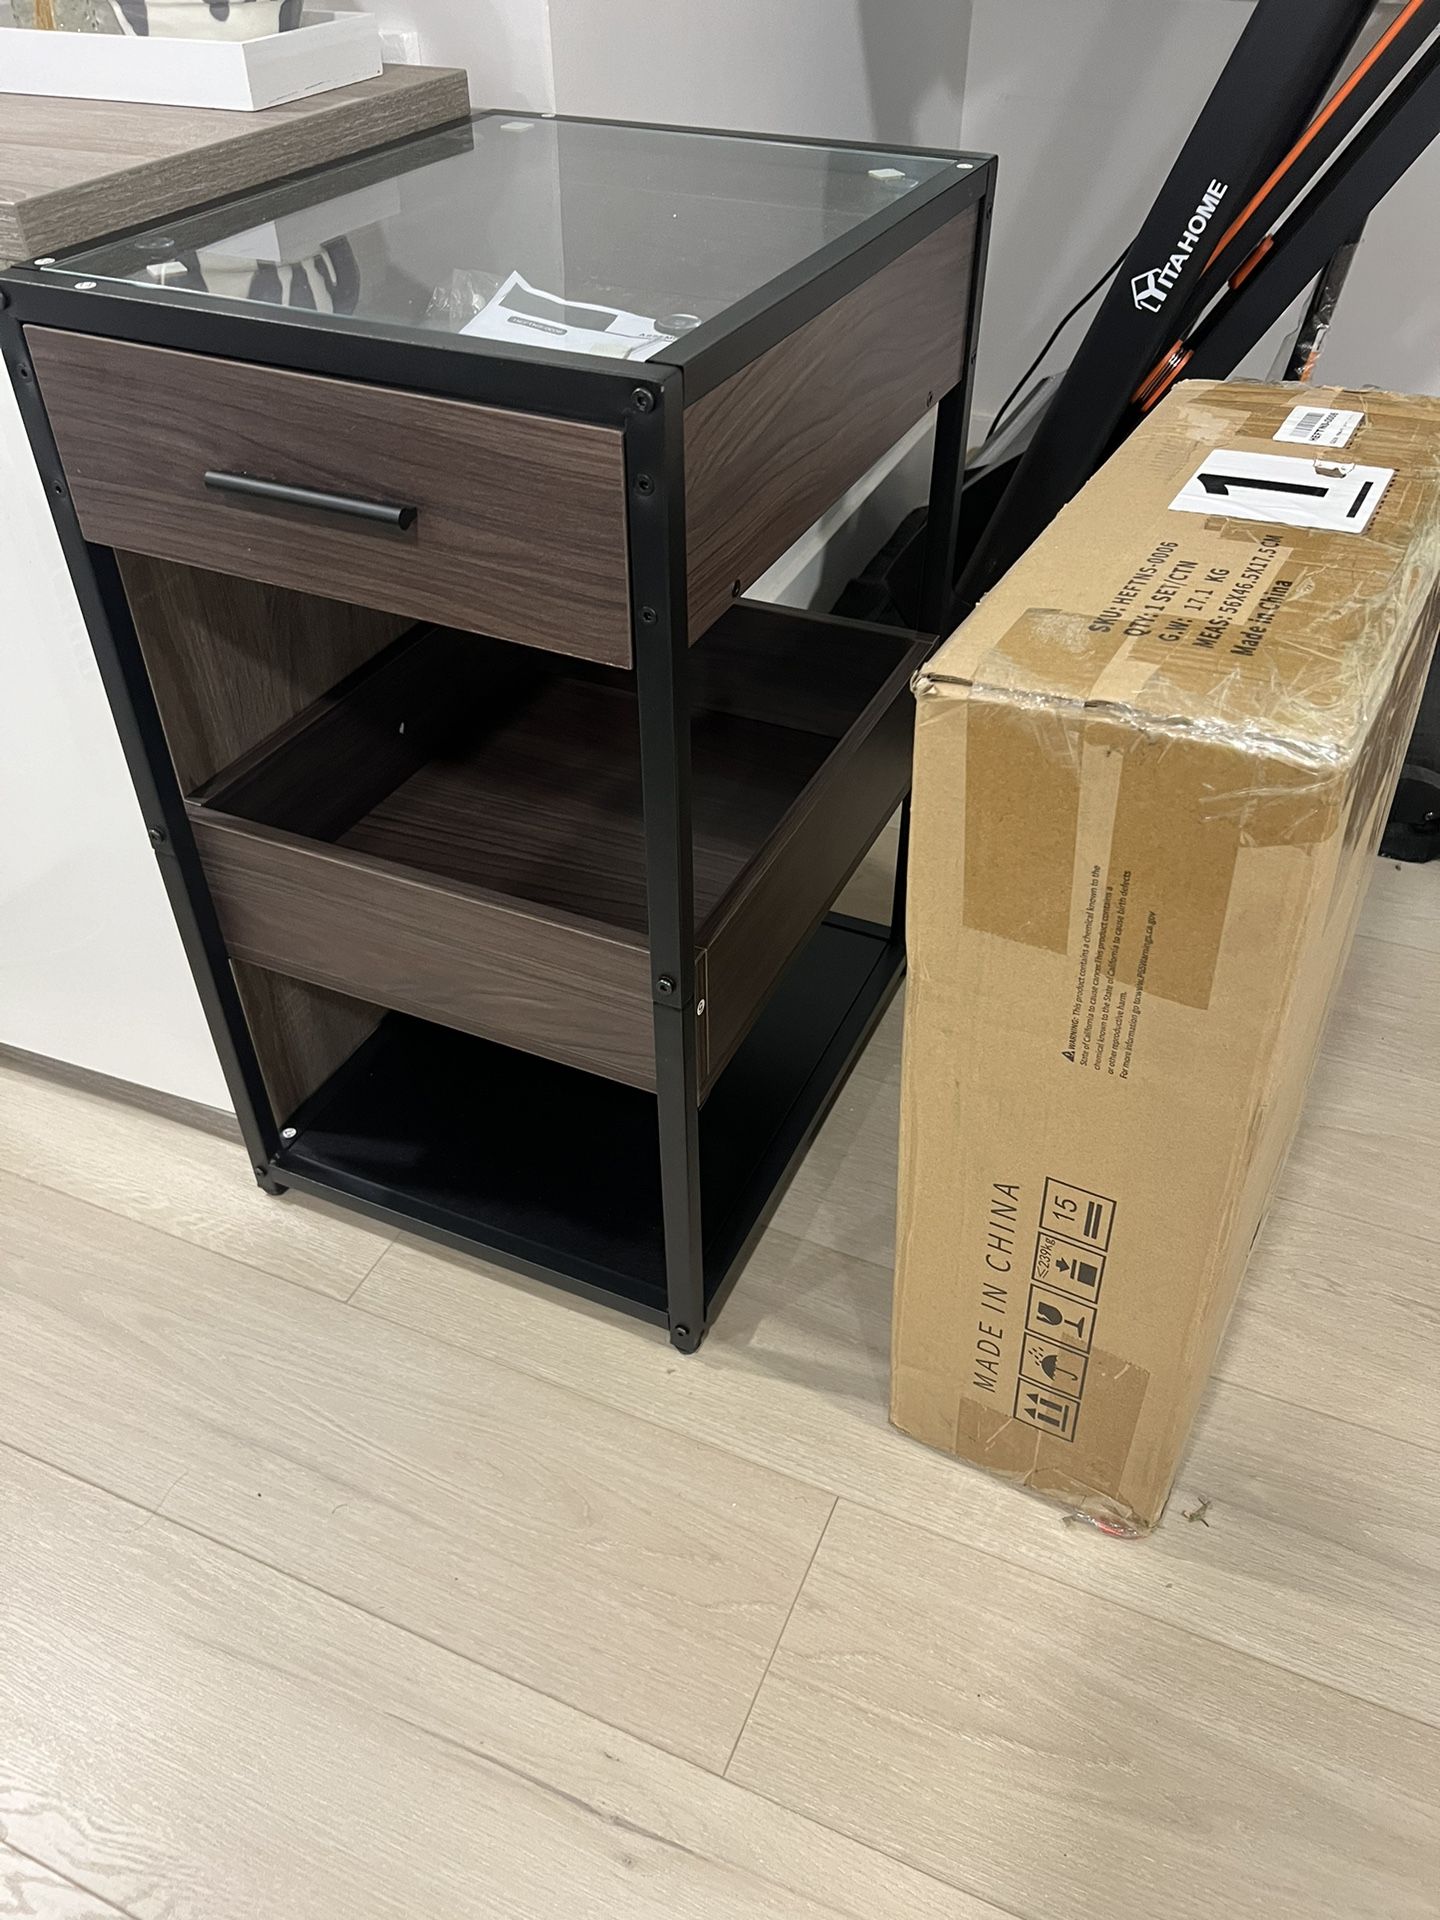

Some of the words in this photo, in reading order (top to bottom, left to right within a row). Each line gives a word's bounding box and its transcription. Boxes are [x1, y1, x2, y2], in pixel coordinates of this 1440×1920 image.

[1114, 541, 1179, 606] HEFTNS-0006
[1123, 612, 1159, 637] QTY:
[1151, 560, 1199, 603] SET/CTN
[1158, 618, 1193, 642] G.W:
[1184, 589, 1214, 612] 17.1
[1205, 568, 1231, 583] KG
[1258, 579, 1294, 611] China
[1247, 610, 1275, 625] in
[1230, 624, 1267, 656] Made
[1092, 865, 1101, 878] the
[1120, 870, 1131, 896] defects
[1087, 888, 1097, 912] known
[1102, 892, 1112, 921] contains
[1117, 897, 1126, 915] birth
[1082, 911, 1094, 943] chemical
[1098, 922, 1108, 950] product
[1115, 916, 1124, 936] cause
[1080, 949, 1089, 976] contains
[1107, 945, 1119, 976] California
[1076, 977, 1086, 1003] product
[1090, 986, 1098, 1004] cause
[1103, 985, 1113, 1002] State
[1117, 992, 1127, 1011] harm.
[1073, 1003, 1081, 1016] This
[1102, 1003, 1110, 1013] the
[1083, 1013, 1094, 1042] California
[1098, 1022, 1107, 1043] known
[1112, 1011, 1124, 1050] reproductive
[1125, 1014, 1137, 1051] information
[1080, 1051, 1088, 1066] State
[1094, 1043, 1104, 1071] chemical
[1108, 1051, 1117, 1067] other
[1123, 1051, 1131, 1068] more
[1119, 1068, 1128, 1079] For
[1053, 1195, 1078, 1222] 15
[985, 1183, 1020, 1273] CHINA
[981, 1282, 1008, 1314] IN
[973, 1321, 1003, 1393] MADE
